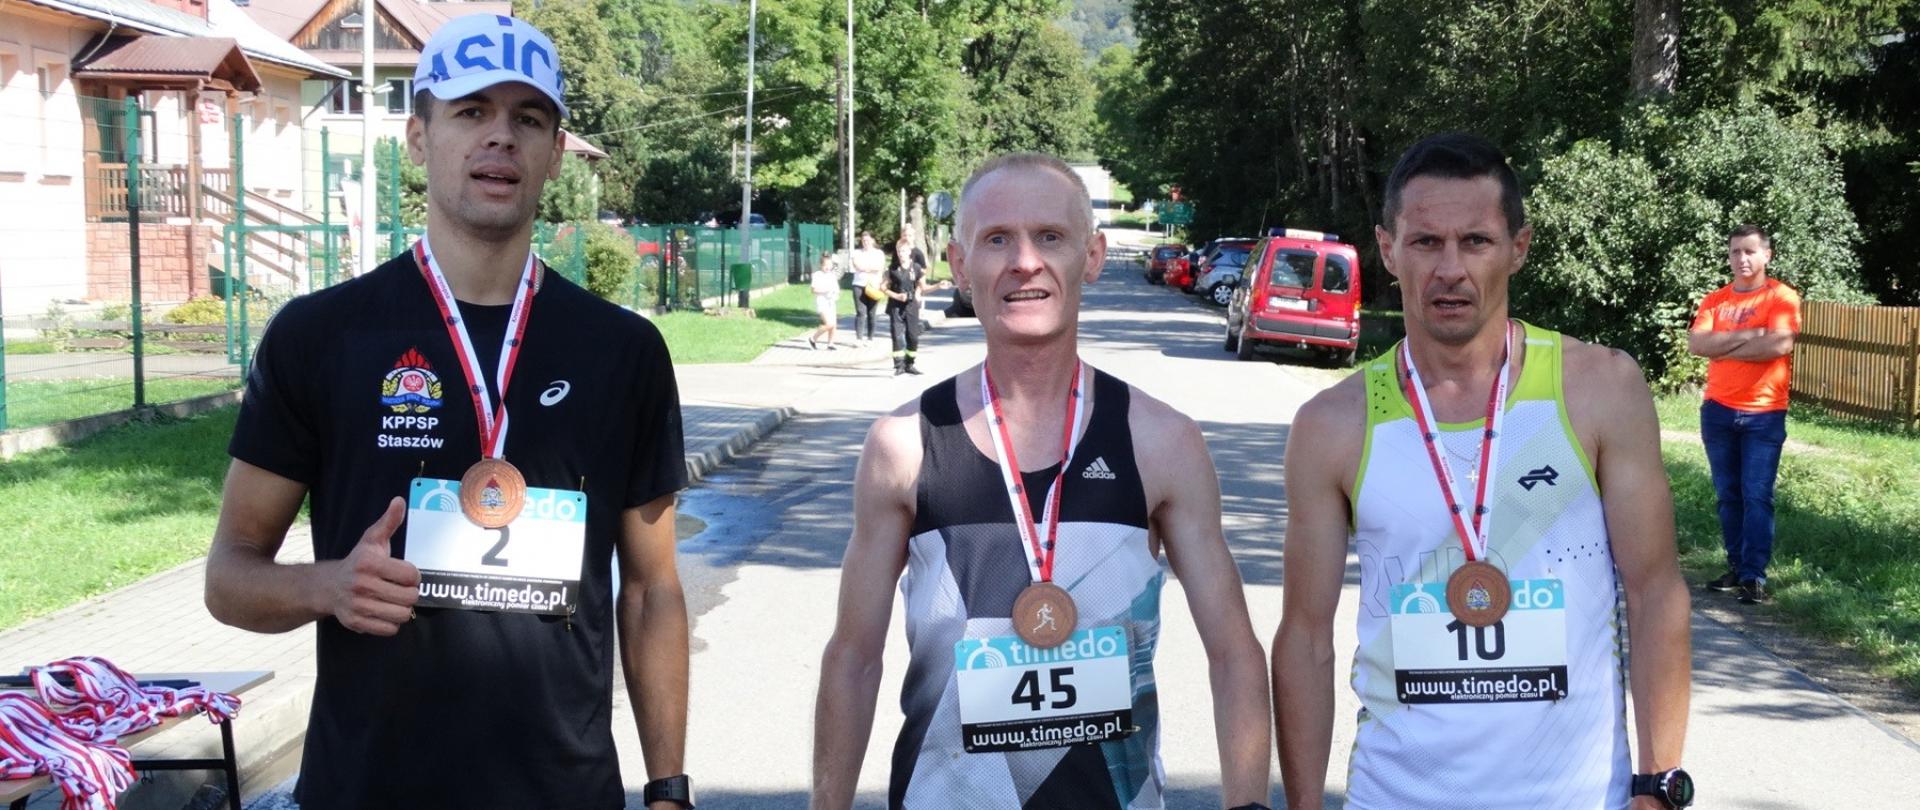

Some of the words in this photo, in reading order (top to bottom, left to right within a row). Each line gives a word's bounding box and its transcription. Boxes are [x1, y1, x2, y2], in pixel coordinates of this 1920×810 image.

[382, 416, 439, 430] KPPSP
[377, 433, 445, 449] Staszów
[1082, 470, 1116, 480] adidas
[481, 525, 510, 567] 2
[1446, 619, 1506, 661] 10
[1011, 667, 1077, 712] 45
[1405, 672, 1558, 698] www.timedo.pl
[1495, 692, 1519, 701] pomiar
[1520, 691, 1538, 699] czasu
[972, 716, 1122, 747] www.timedo.pl
